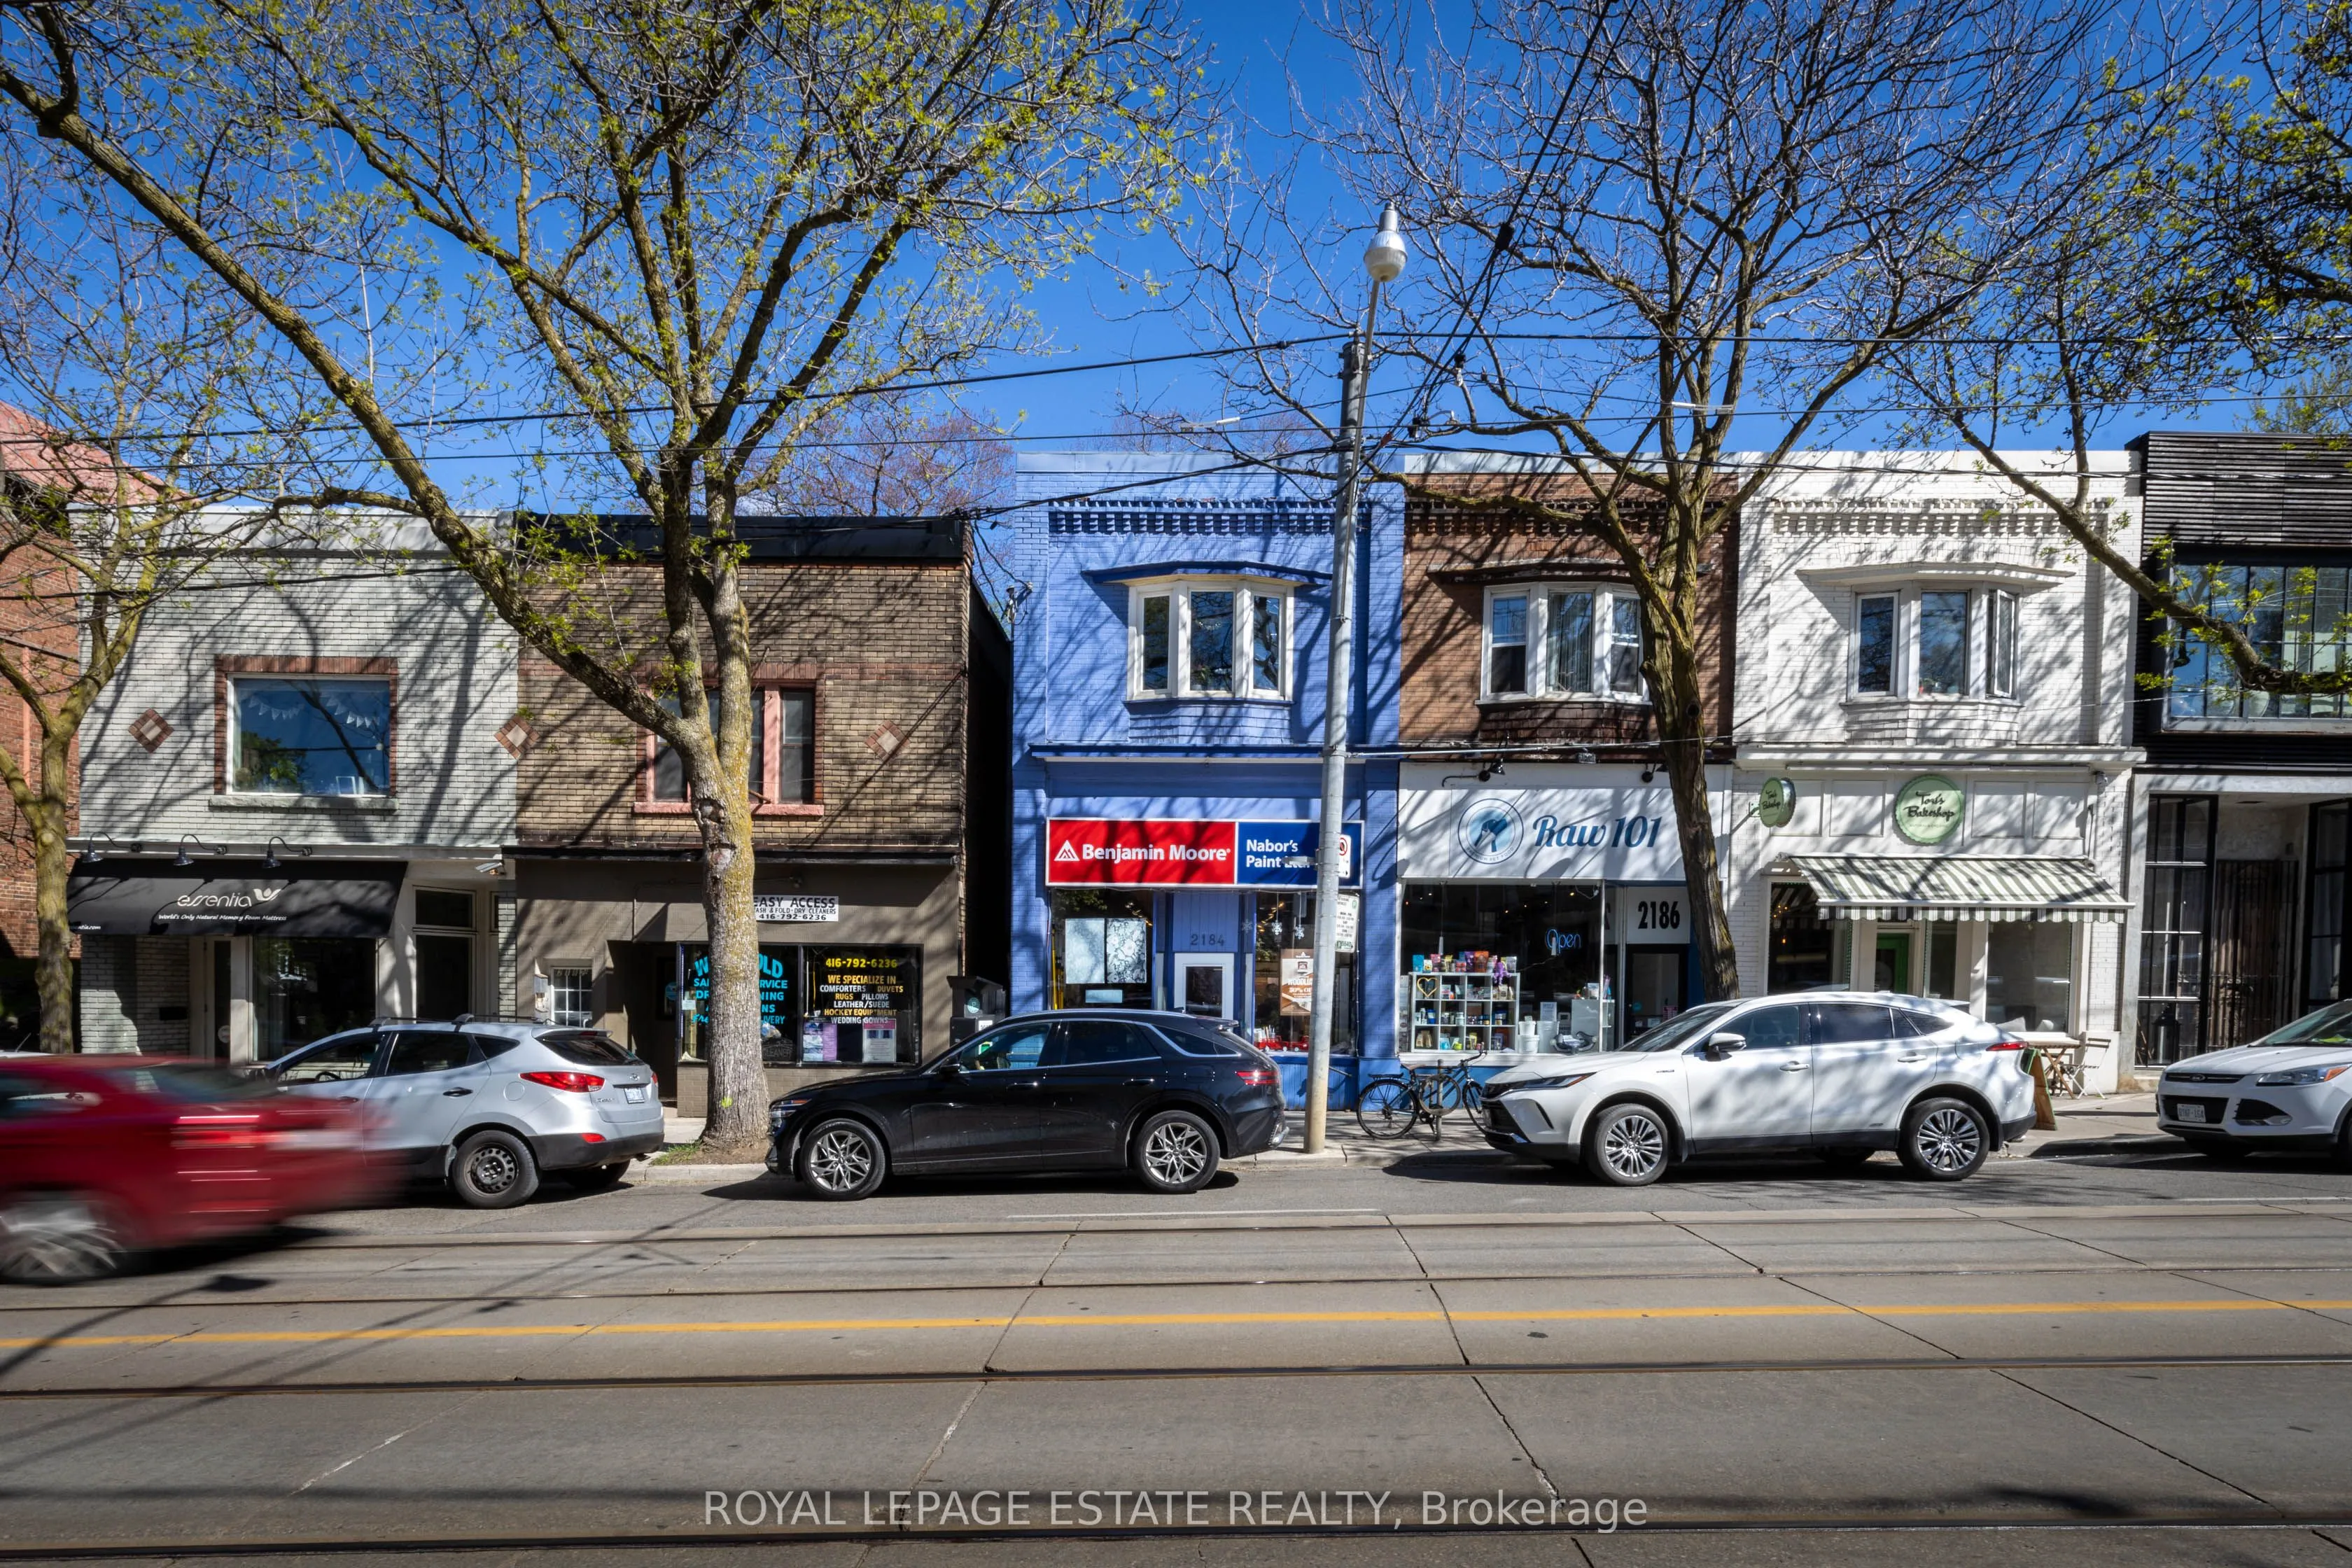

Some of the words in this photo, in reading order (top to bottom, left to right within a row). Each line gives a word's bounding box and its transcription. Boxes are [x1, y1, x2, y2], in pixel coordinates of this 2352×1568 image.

[1903, 805, 1956, 822] Bakeshop
[1533, 815, 1606, 847] Raw
[1611, 815, 1662, 848] 101
[1246, 839, 1298, 852] Nabor's
[1082, 844, 1165, 864] Benjamin
[1169, 844, 1227, 861] Moore
[1246, 855, 1282, 868] Paint
[177, 892, 252, 907] essentia
[790, 897, 835, 909] ACCESS
[1638, 901, 1680, 929] 2186
[1190, 933, 1225, 946] 2184
[1546, 929, 1582, 954] Open
[825, 958, 897, 967] 416-792-6236
[760, 979, 788, 988] RVICE
[827, 974, 841, 984] WE
[842, 975, 884, 984] SPECIALIZE
[886, 975, 896, 984] IN
[760, 991, 784, 1001] NING
